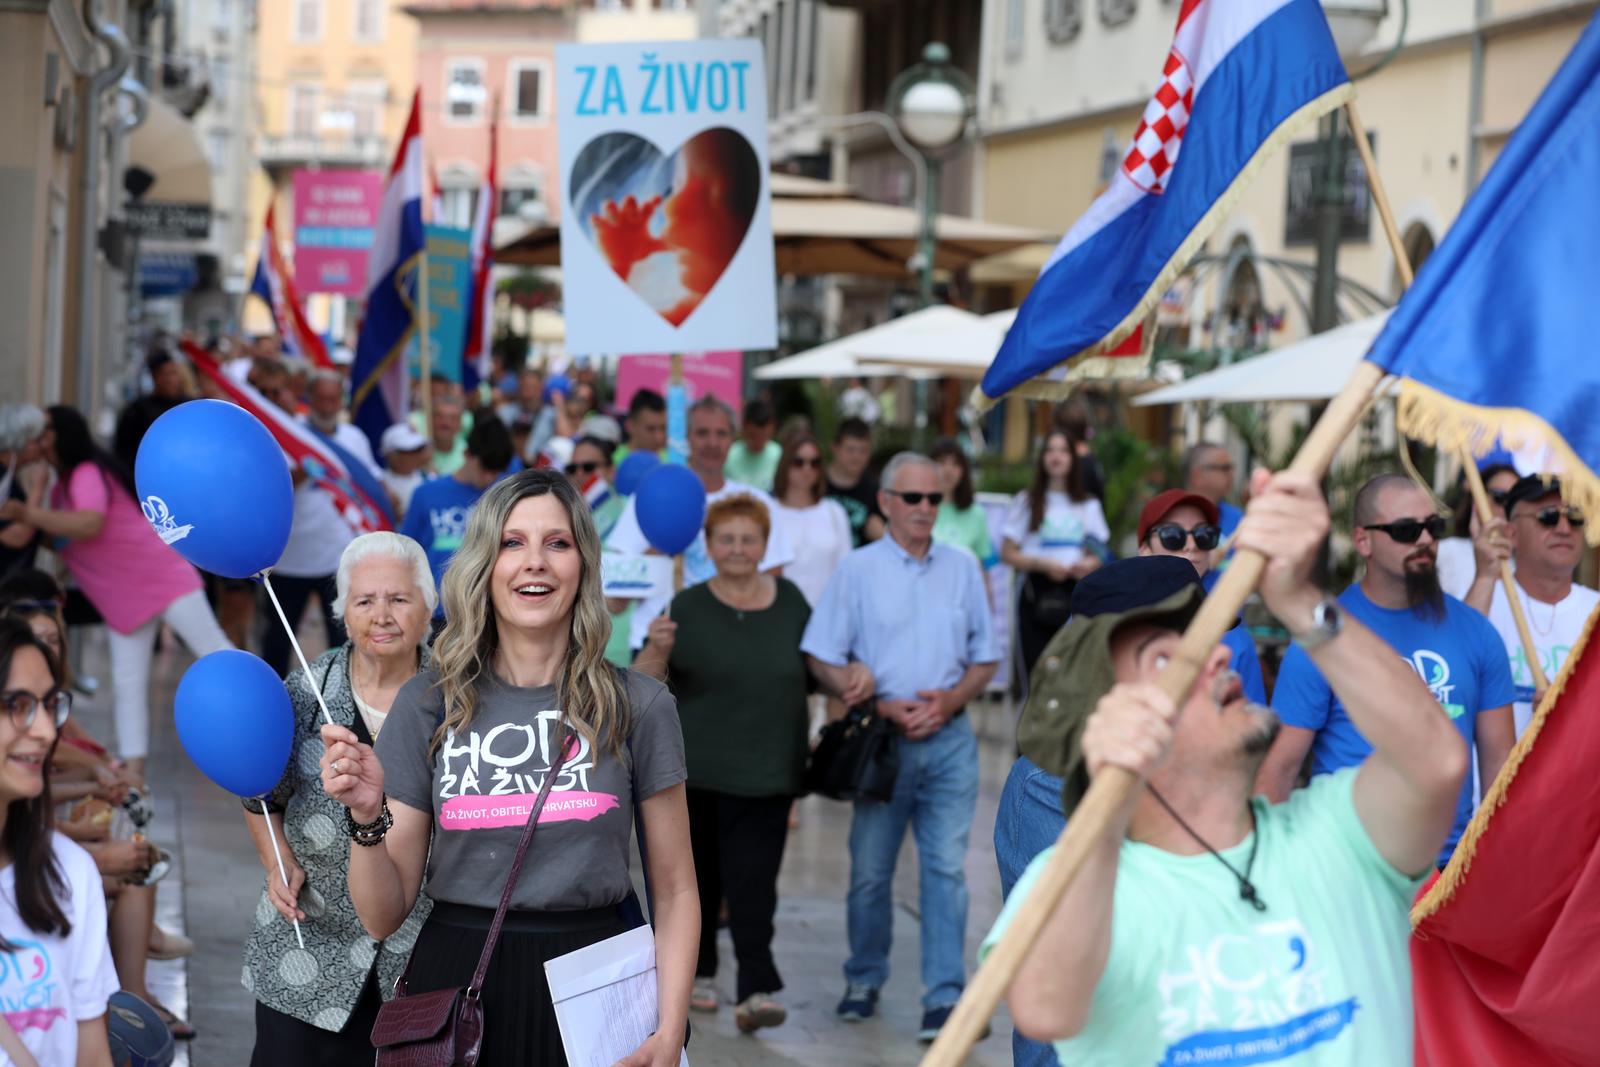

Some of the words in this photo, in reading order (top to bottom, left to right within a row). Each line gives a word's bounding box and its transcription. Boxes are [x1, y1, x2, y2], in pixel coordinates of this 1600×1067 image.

[575, 64, 627, 116] ZA
[639, 52, 751, 114] ŽIVOT
[442, 710, 591, 777] HOD
[439, 764, 482, 799] ZA
[488, 762, 594, 797] ŽIVOT
[446, 809, 457, 820] ZA
[457, 808, 490, 820] ŽIVOT,
[542, 799, 598, 813] HRVATSKU
